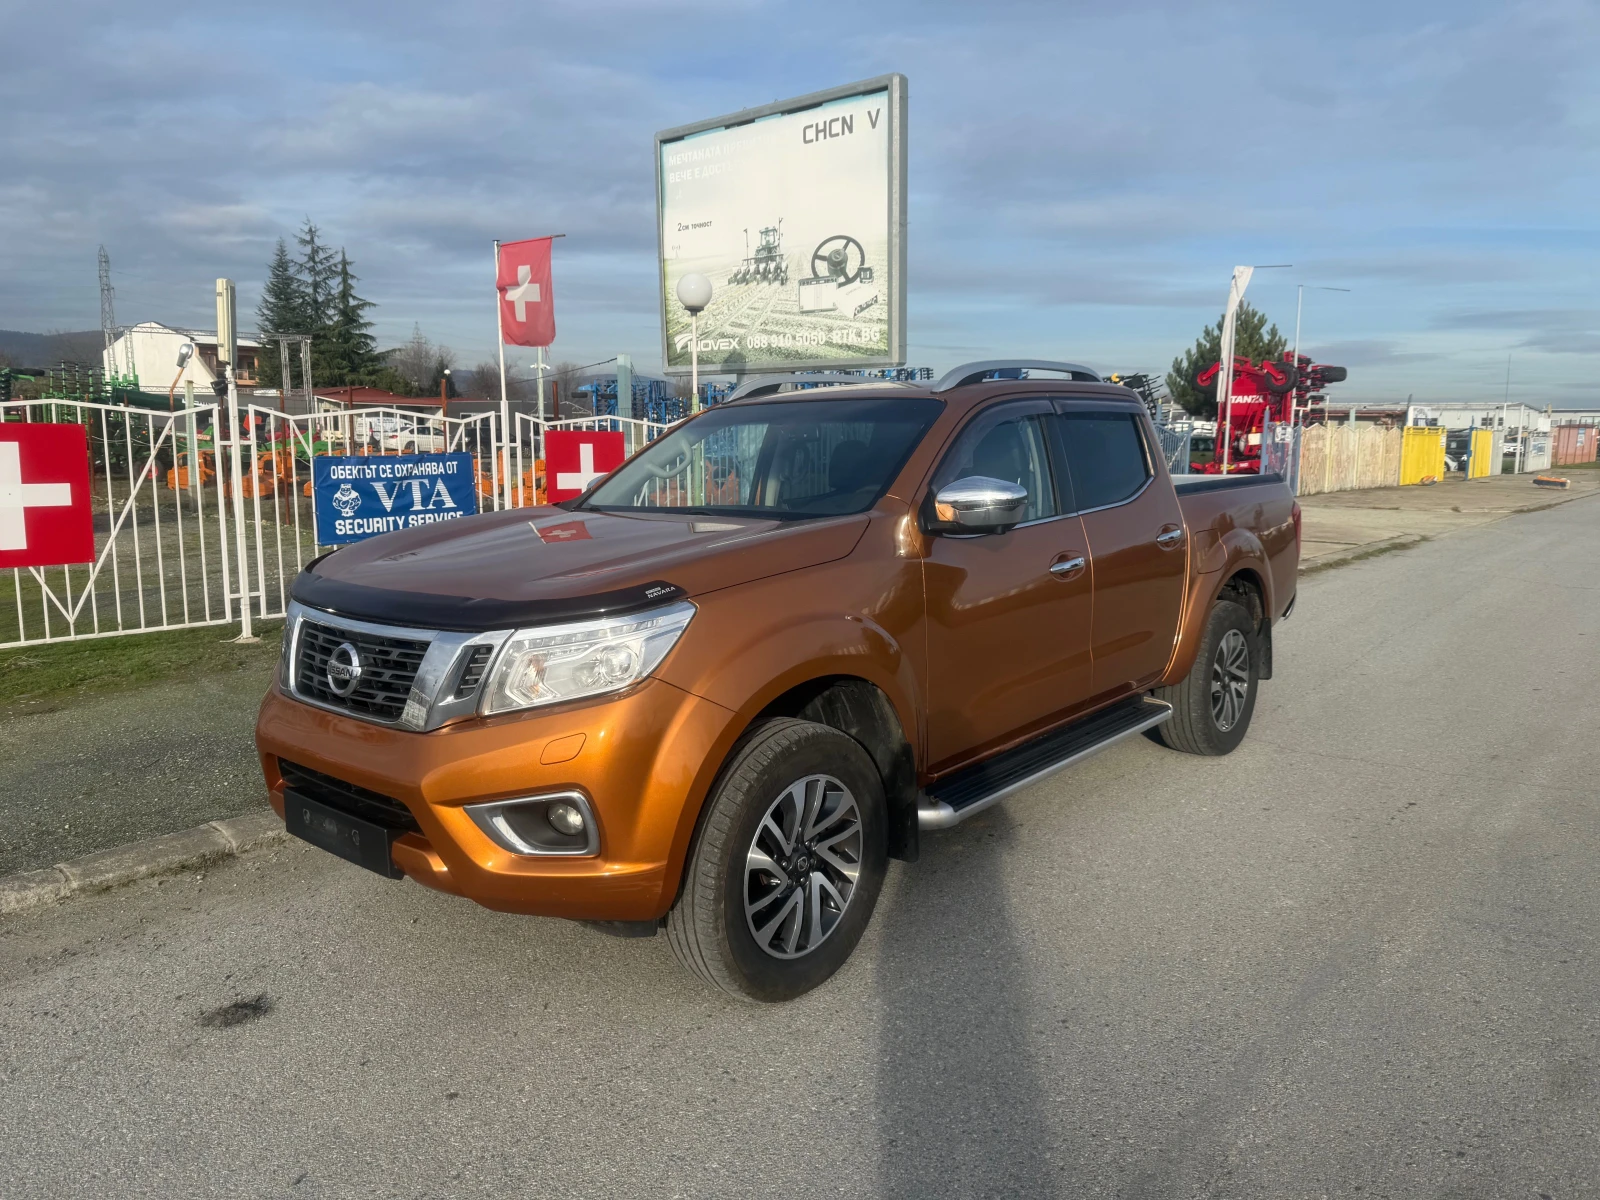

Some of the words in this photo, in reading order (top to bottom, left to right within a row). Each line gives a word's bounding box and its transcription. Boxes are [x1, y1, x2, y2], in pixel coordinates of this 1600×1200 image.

[803, 114, 854, 144] CHCN
[668, 144, 722, 167] МЕЧТАНАТА
[669, 169, 693, 184] ВЕЧЕ
[687, 337, 740, 352] INOVEX
[747, 335, 768, 349] 088
[770, 333, 792, 347] 910
[795, 332, 826, 346] 5050
[330, 464, 377, 480] ОБЕКТЪТ
[379, 464, 392, 478] СЕ
[394, 462, 445, 477] ОХРАНЯВА
[446, 461, 458, 474] ОТ
[370, 477, 457, 513] VTA
[335, 515, 405, 535] SECURITY
[647, 586, 676, 599] NAVARA
